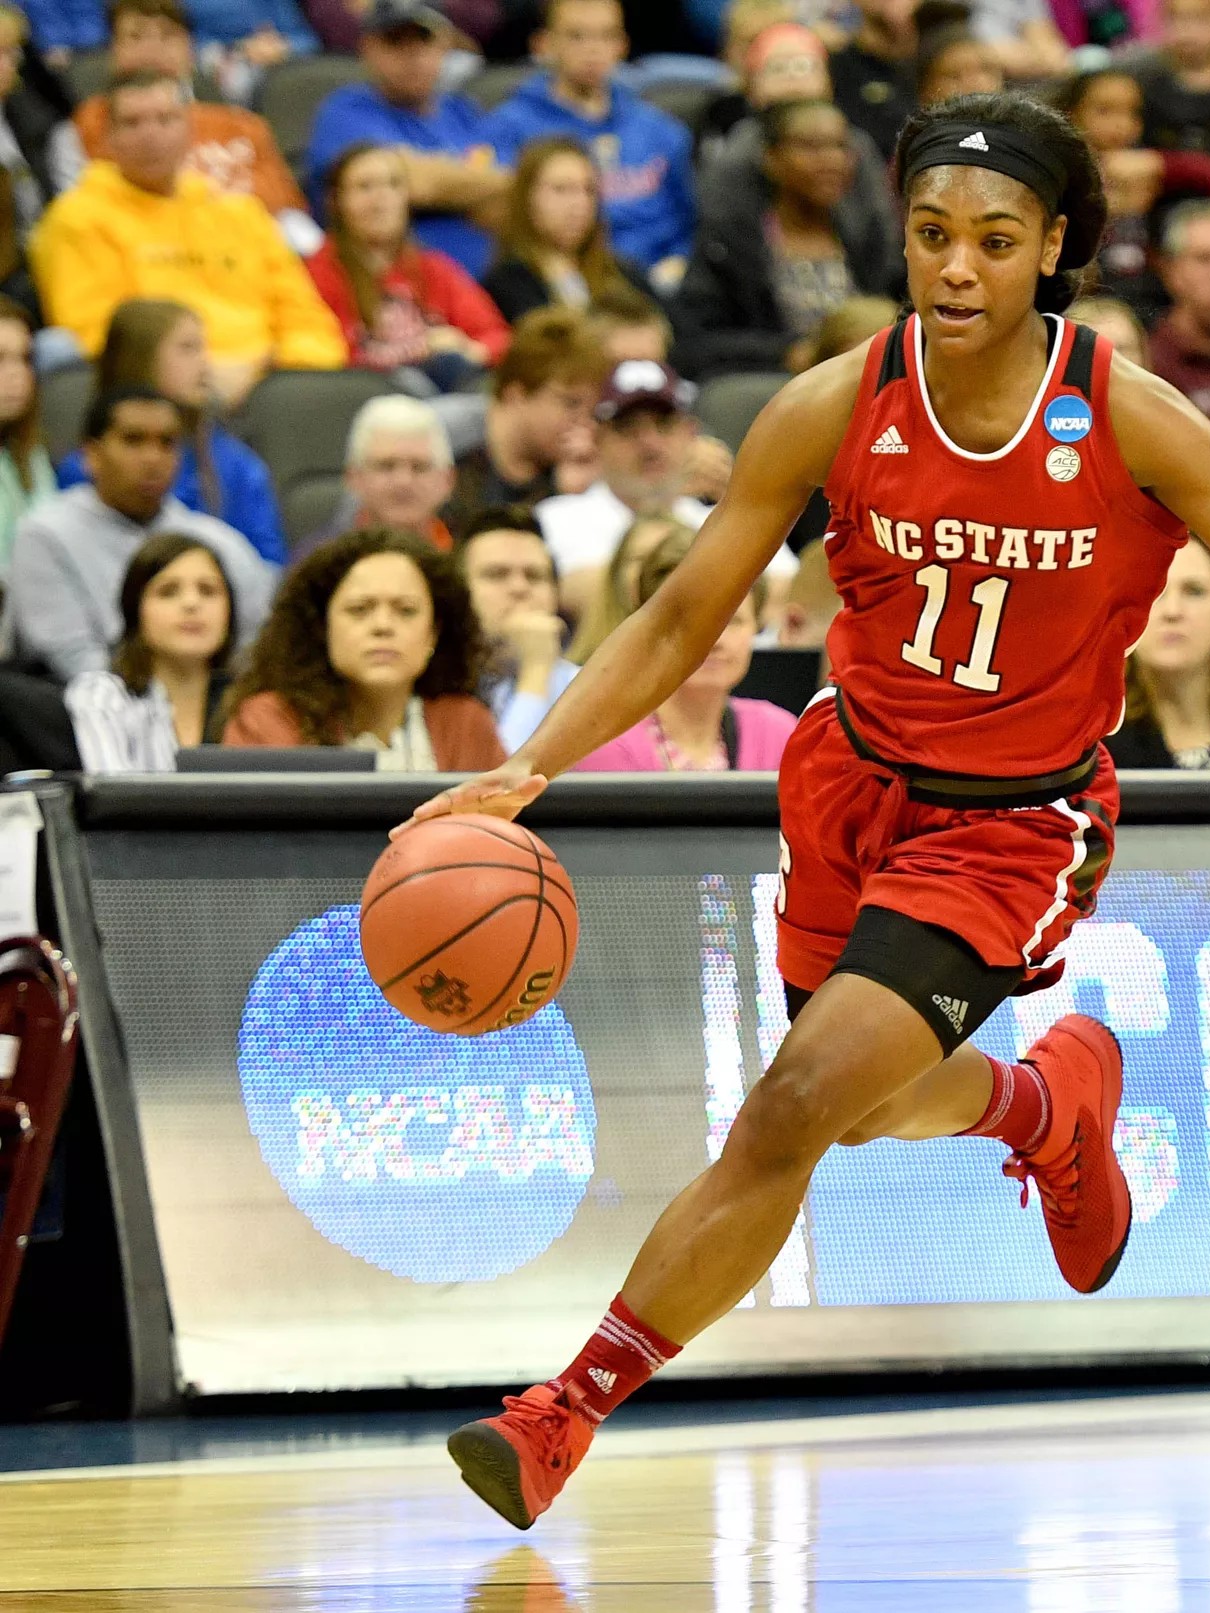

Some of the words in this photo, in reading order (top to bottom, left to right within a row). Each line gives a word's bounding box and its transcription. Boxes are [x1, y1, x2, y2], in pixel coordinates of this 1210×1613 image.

[1050, 416, 1090, 431] NCAA
[870, 443, 909, 454] adidas
[1052, 457, 1079, 466] ACC
[868, 508, 924, 562] NC
[933, 518, 1098, 571] STATE
[900, 562, 1011, 694] 11
[931, 993, 964, 1035] adidas
